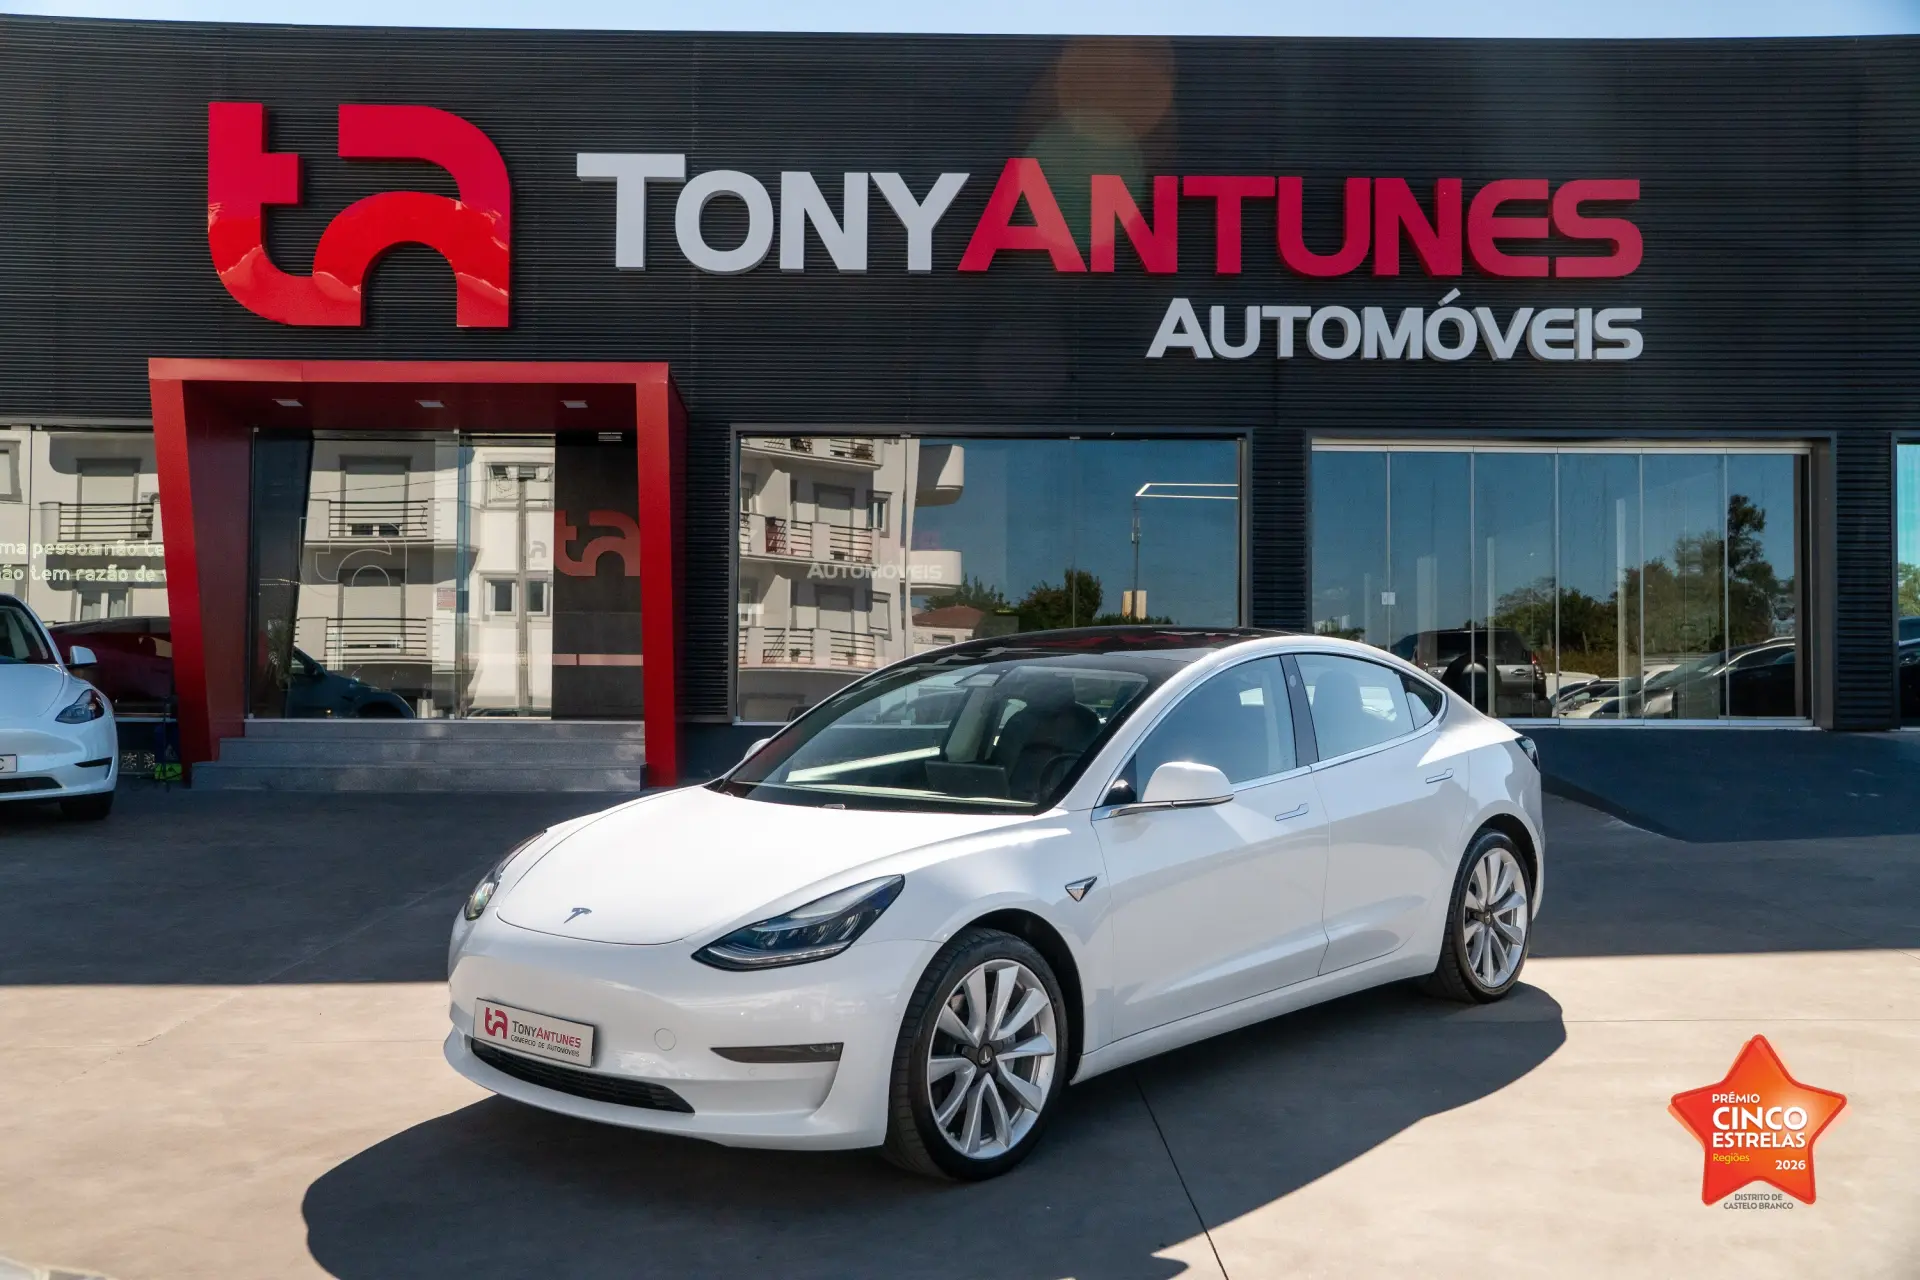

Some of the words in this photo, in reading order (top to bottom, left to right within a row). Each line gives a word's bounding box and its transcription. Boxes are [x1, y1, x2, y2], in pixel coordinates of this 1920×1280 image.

[1146, 288, 1644, 361] AUTOMÓVEIS
[32, 543, 100, 559] pessoa
[104, 540, 137, 556] não
[30, 564, 70, 581] tem
[76, 564, 129, 582] razão
[135, 564, 156, 582] de
[807, 561, 943, 580] AUTOMÓVEIS
